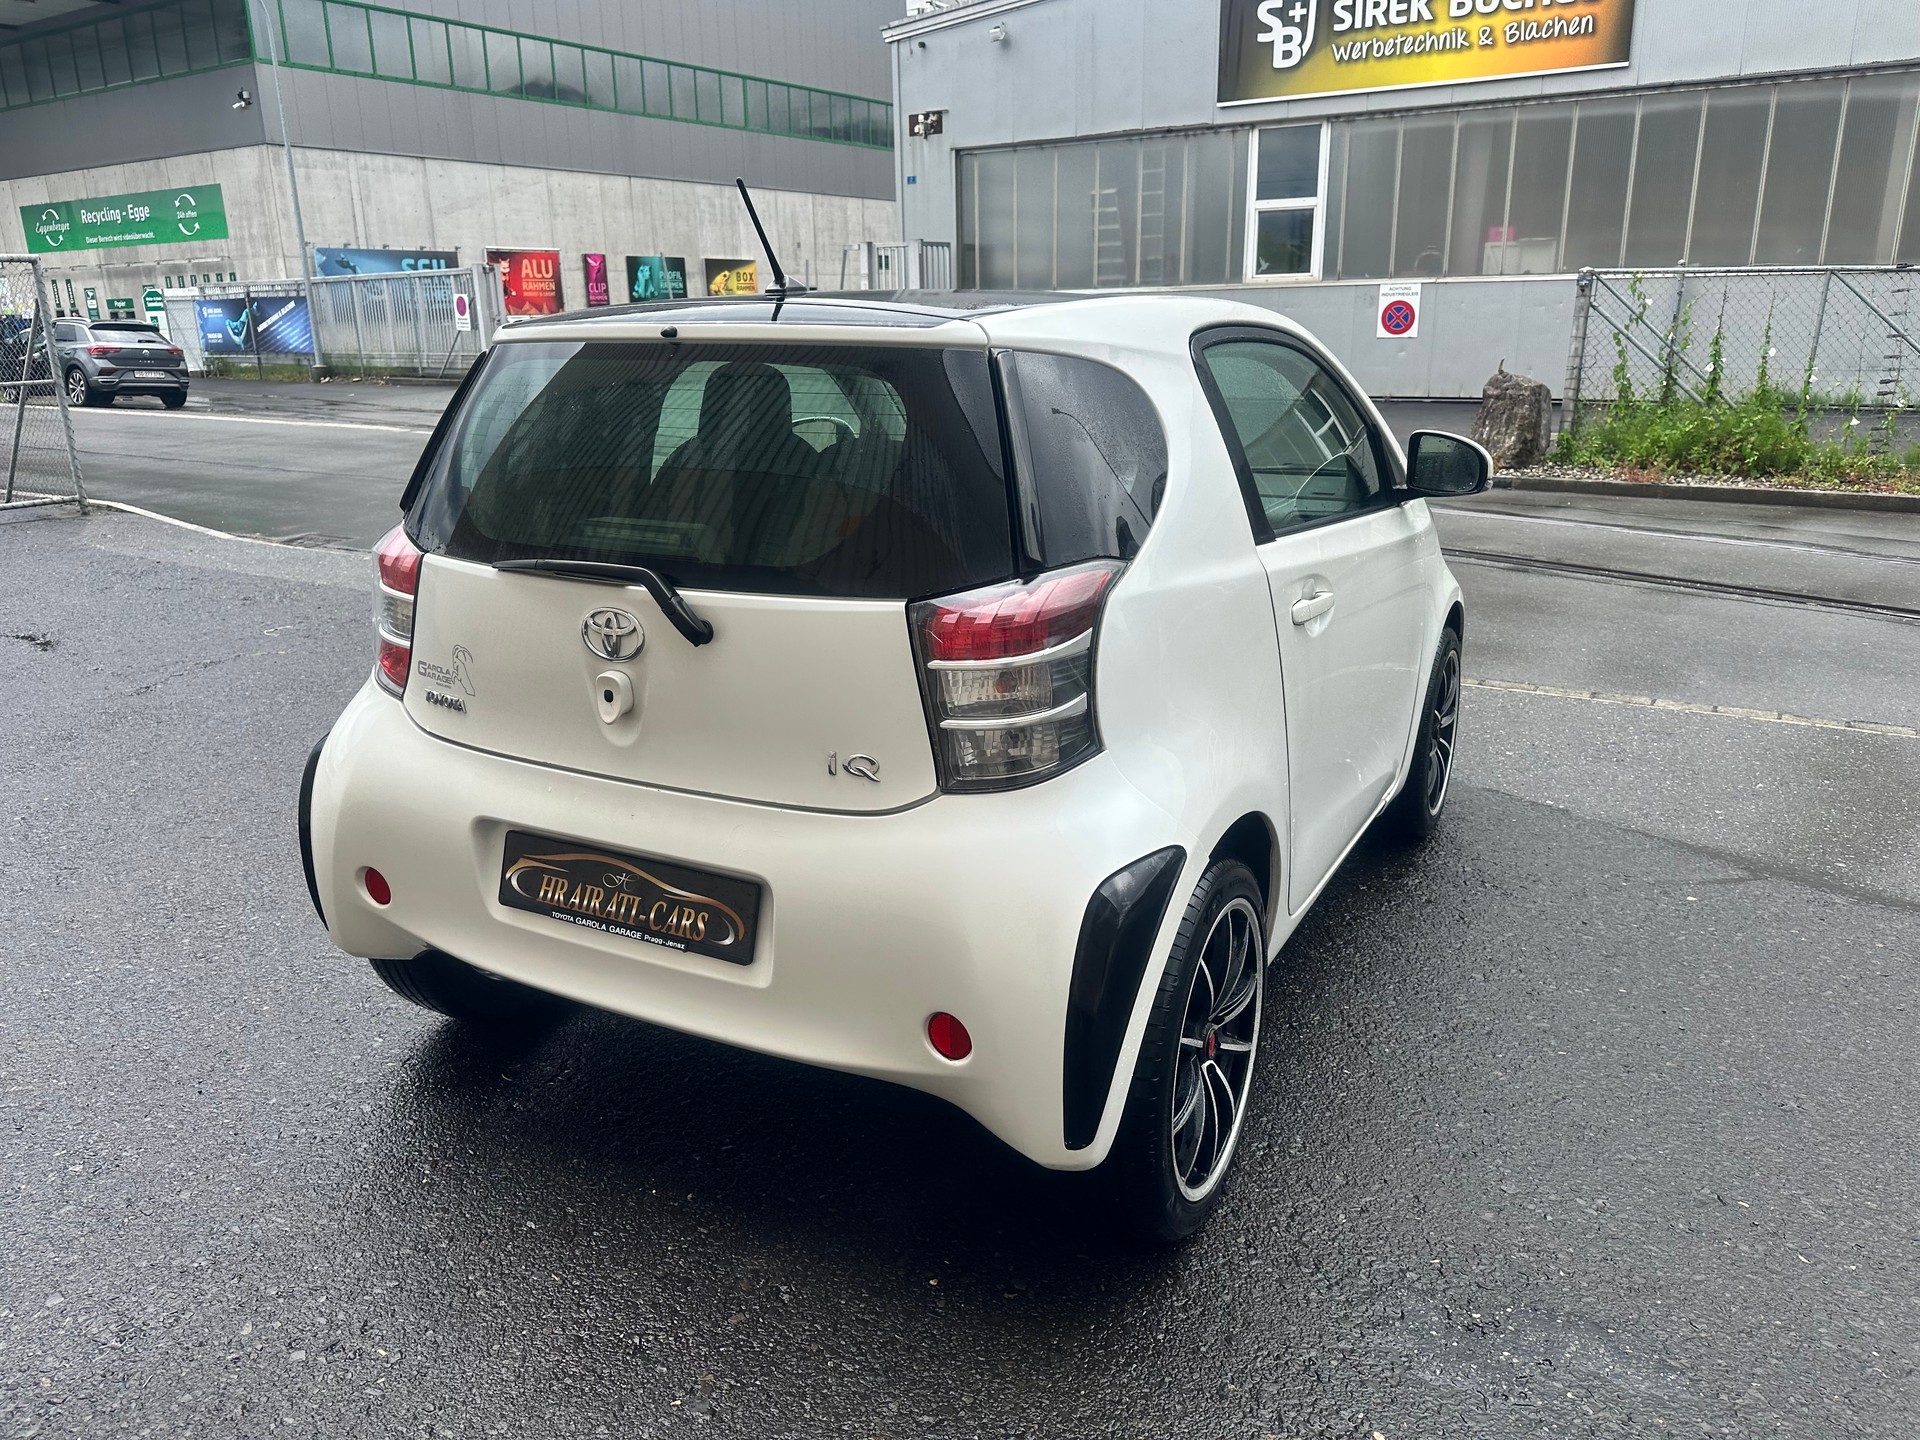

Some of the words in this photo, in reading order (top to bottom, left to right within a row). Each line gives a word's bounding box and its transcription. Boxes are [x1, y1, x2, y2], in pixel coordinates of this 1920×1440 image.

[1332, 28, 1470, 62] Werbetechnik
[1478, 27, 1493, 46] &
[1504, 14, 1593, 44] Blachen
[80, 206, 121, 226] Recycling
[127, 204, 150, 222] Egge
[36, 220, 70, 235] Eggenberger
[521, 259, 553, 278] ALU
[736, 271, 754, 282] BOX
[522, 281, 556, 291] RAHMEN
[588, 282, 606, 293] CLIP
[660, 281, 683, 289] RAMEN
[552, 911, 574, 923] TOYOTA
[575, 917, 607, 932] GAROLA
[608, 925, 642, 940] GARAGE
